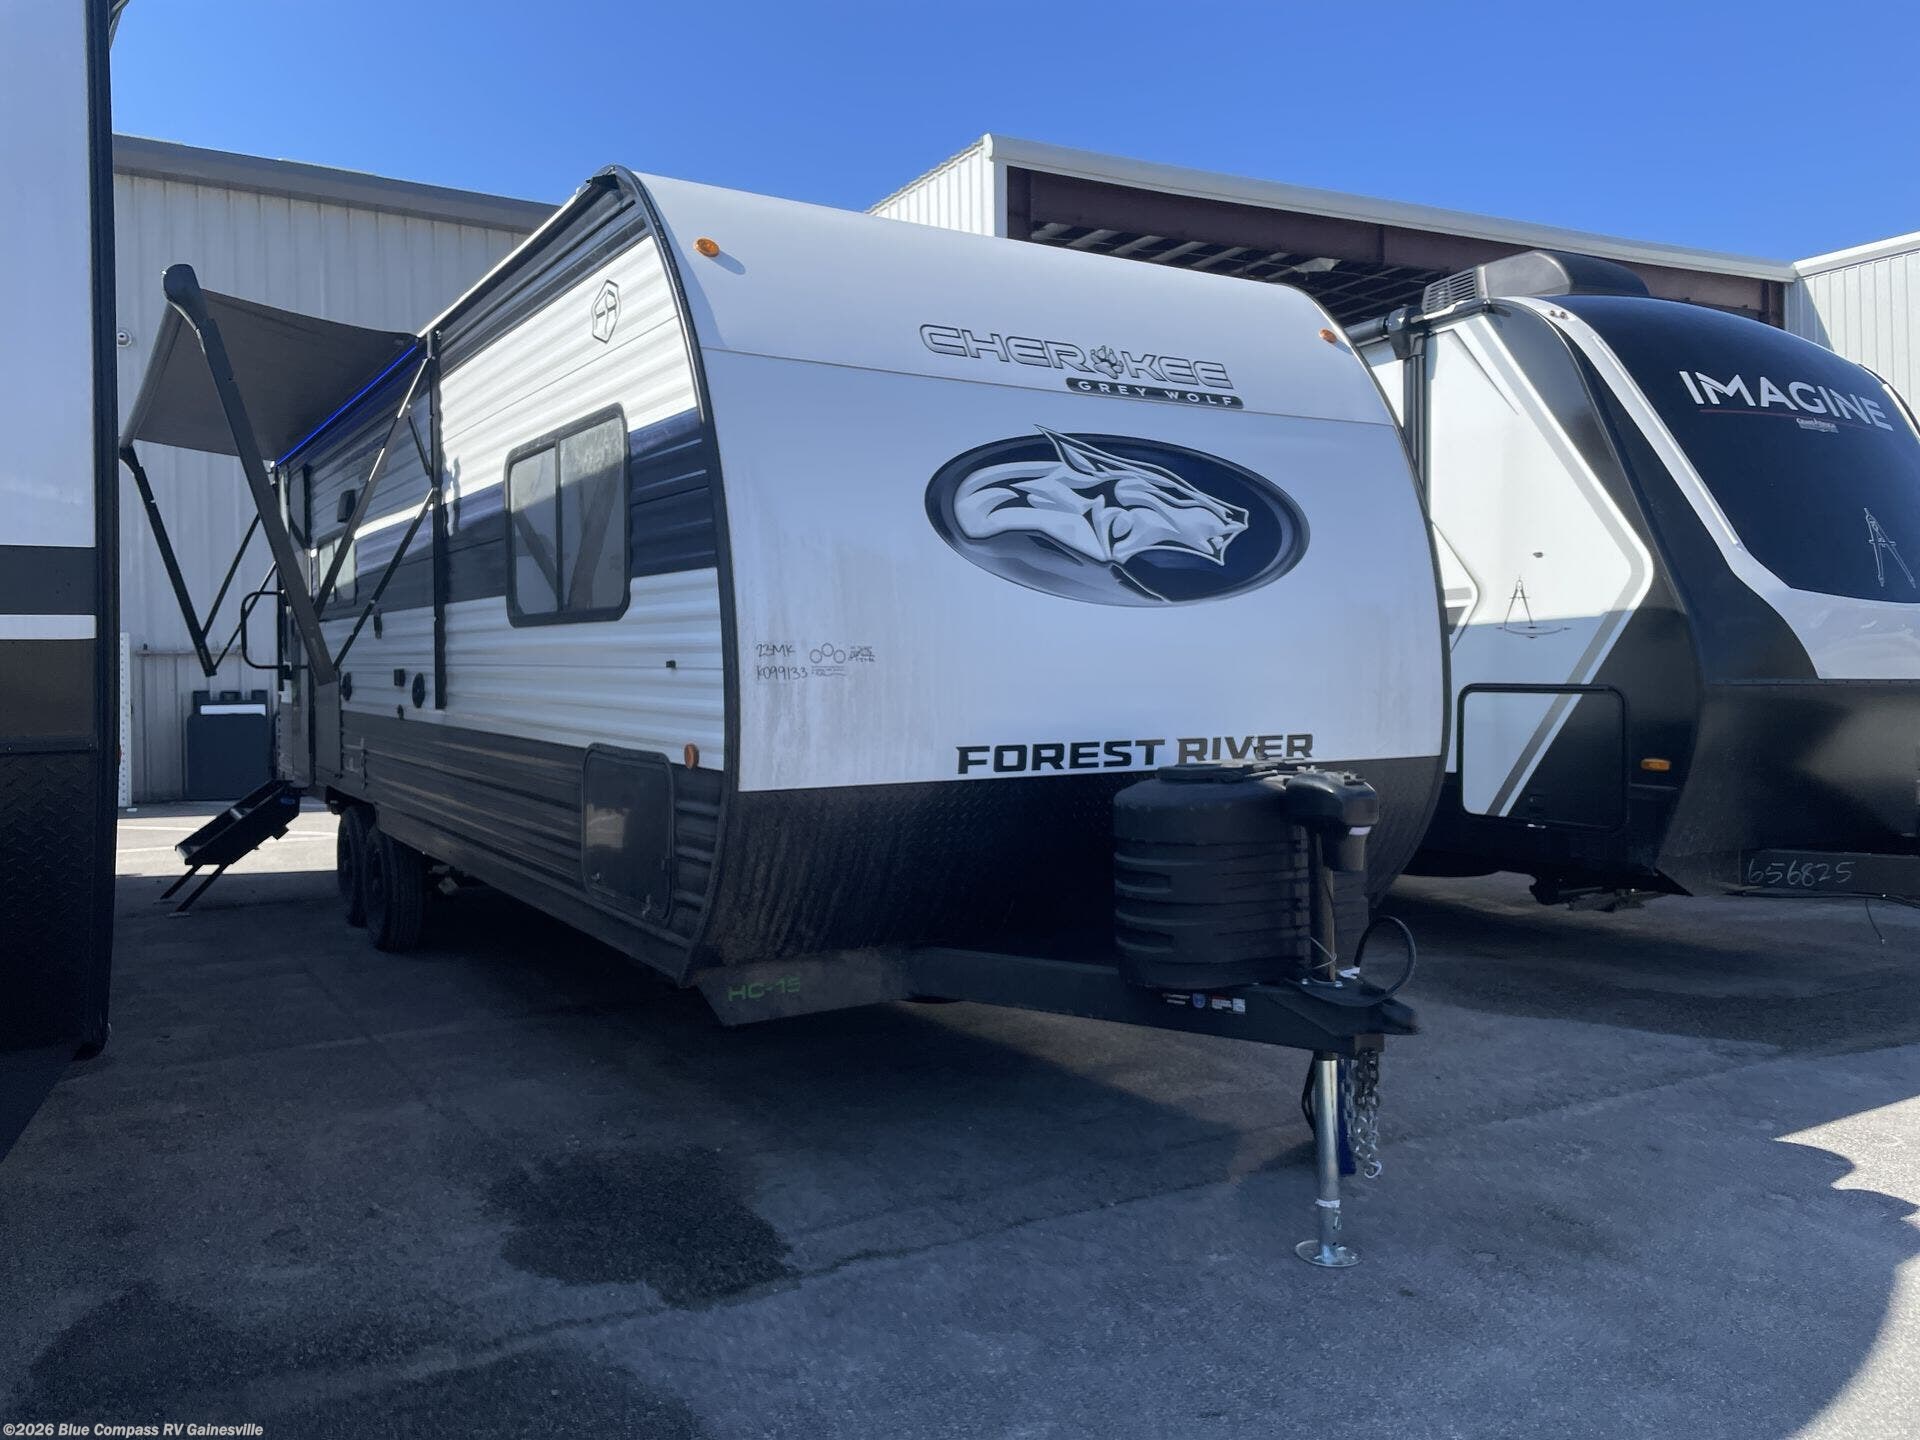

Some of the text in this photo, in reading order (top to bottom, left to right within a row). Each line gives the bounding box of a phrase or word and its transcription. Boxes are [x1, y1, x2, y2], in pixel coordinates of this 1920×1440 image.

[1077, 381, 1232, 406] GREY WOLF
[1679, 370, 1894, 431] IMAGINE
[955, 733, 1313, 775] FOREST RIVER
[1747, 858, 1856, 887] 656825
